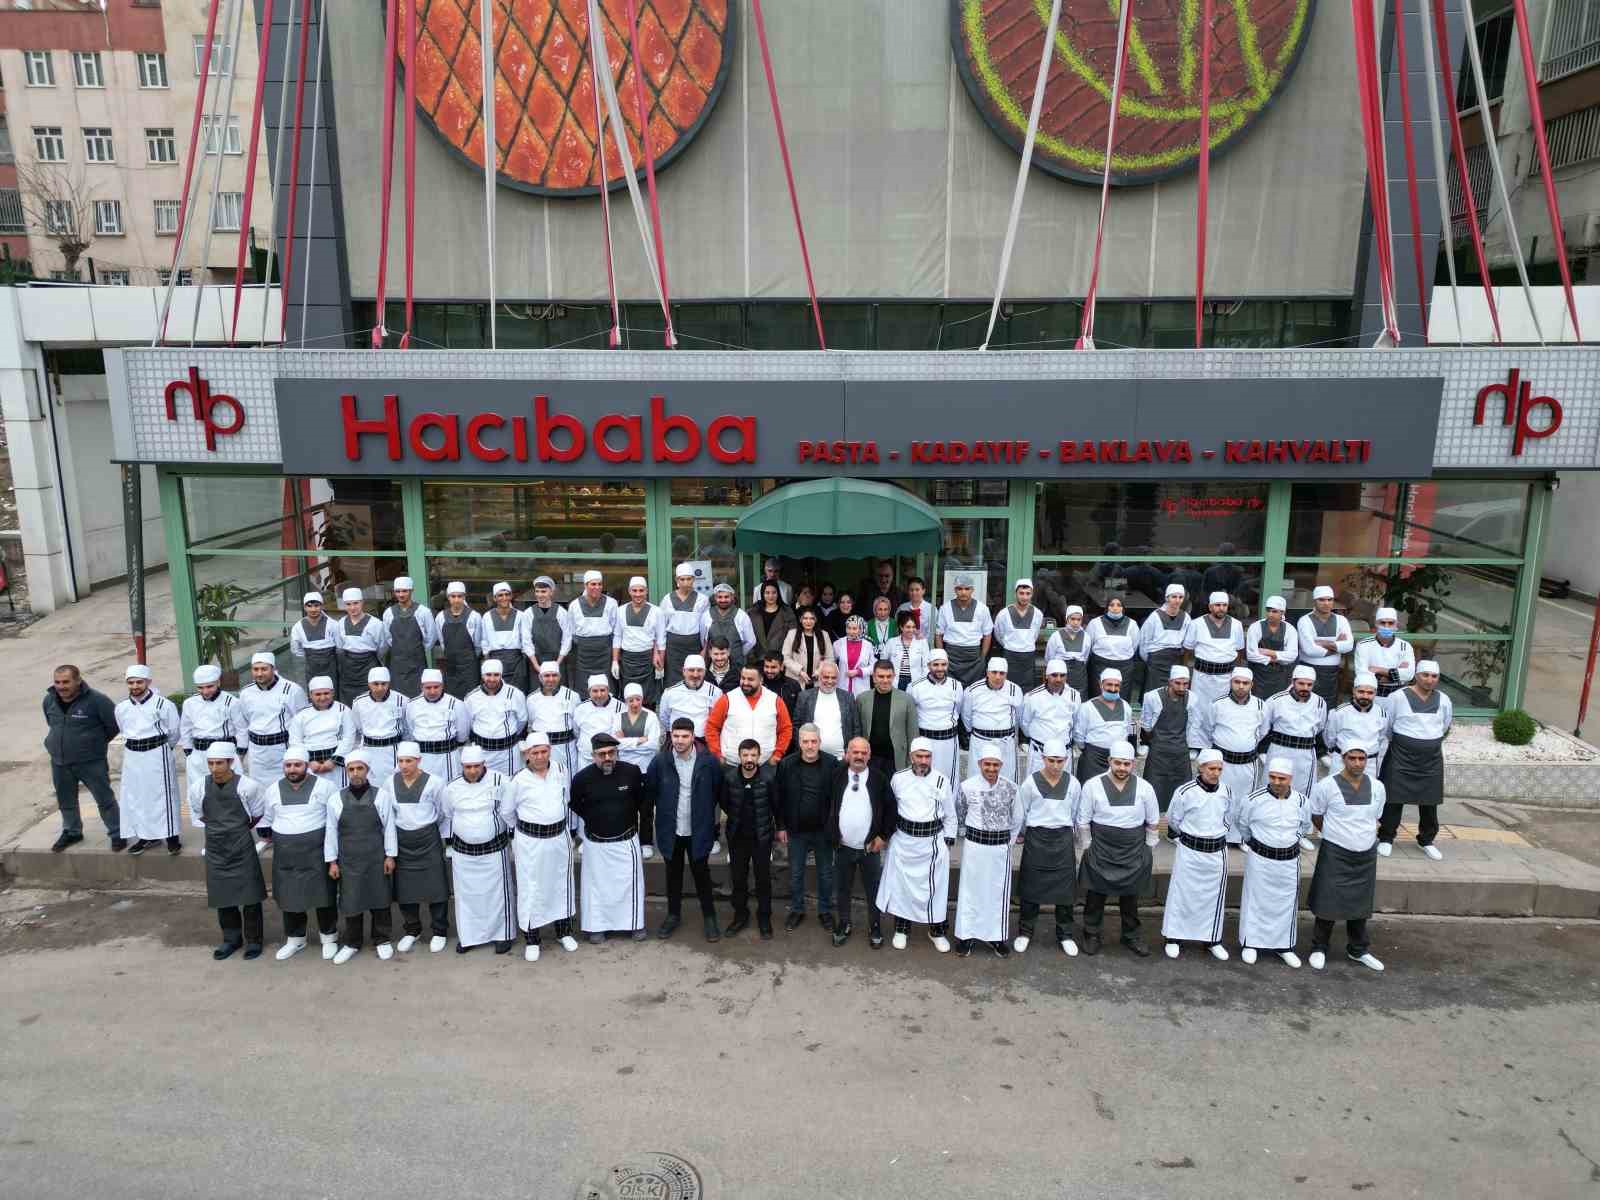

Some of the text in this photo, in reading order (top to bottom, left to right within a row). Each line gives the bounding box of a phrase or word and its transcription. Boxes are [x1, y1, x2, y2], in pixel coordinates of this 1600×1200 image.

[340, 394, 758, 463] Hacıbaba
[797, 440, 881, 464] PASTA
[911, 440, 1030, 464] KADAYIF
[1058, 440, 1192, 464] BAKLAVA
[1224, 439, 1371, 464] KAHVALTI
